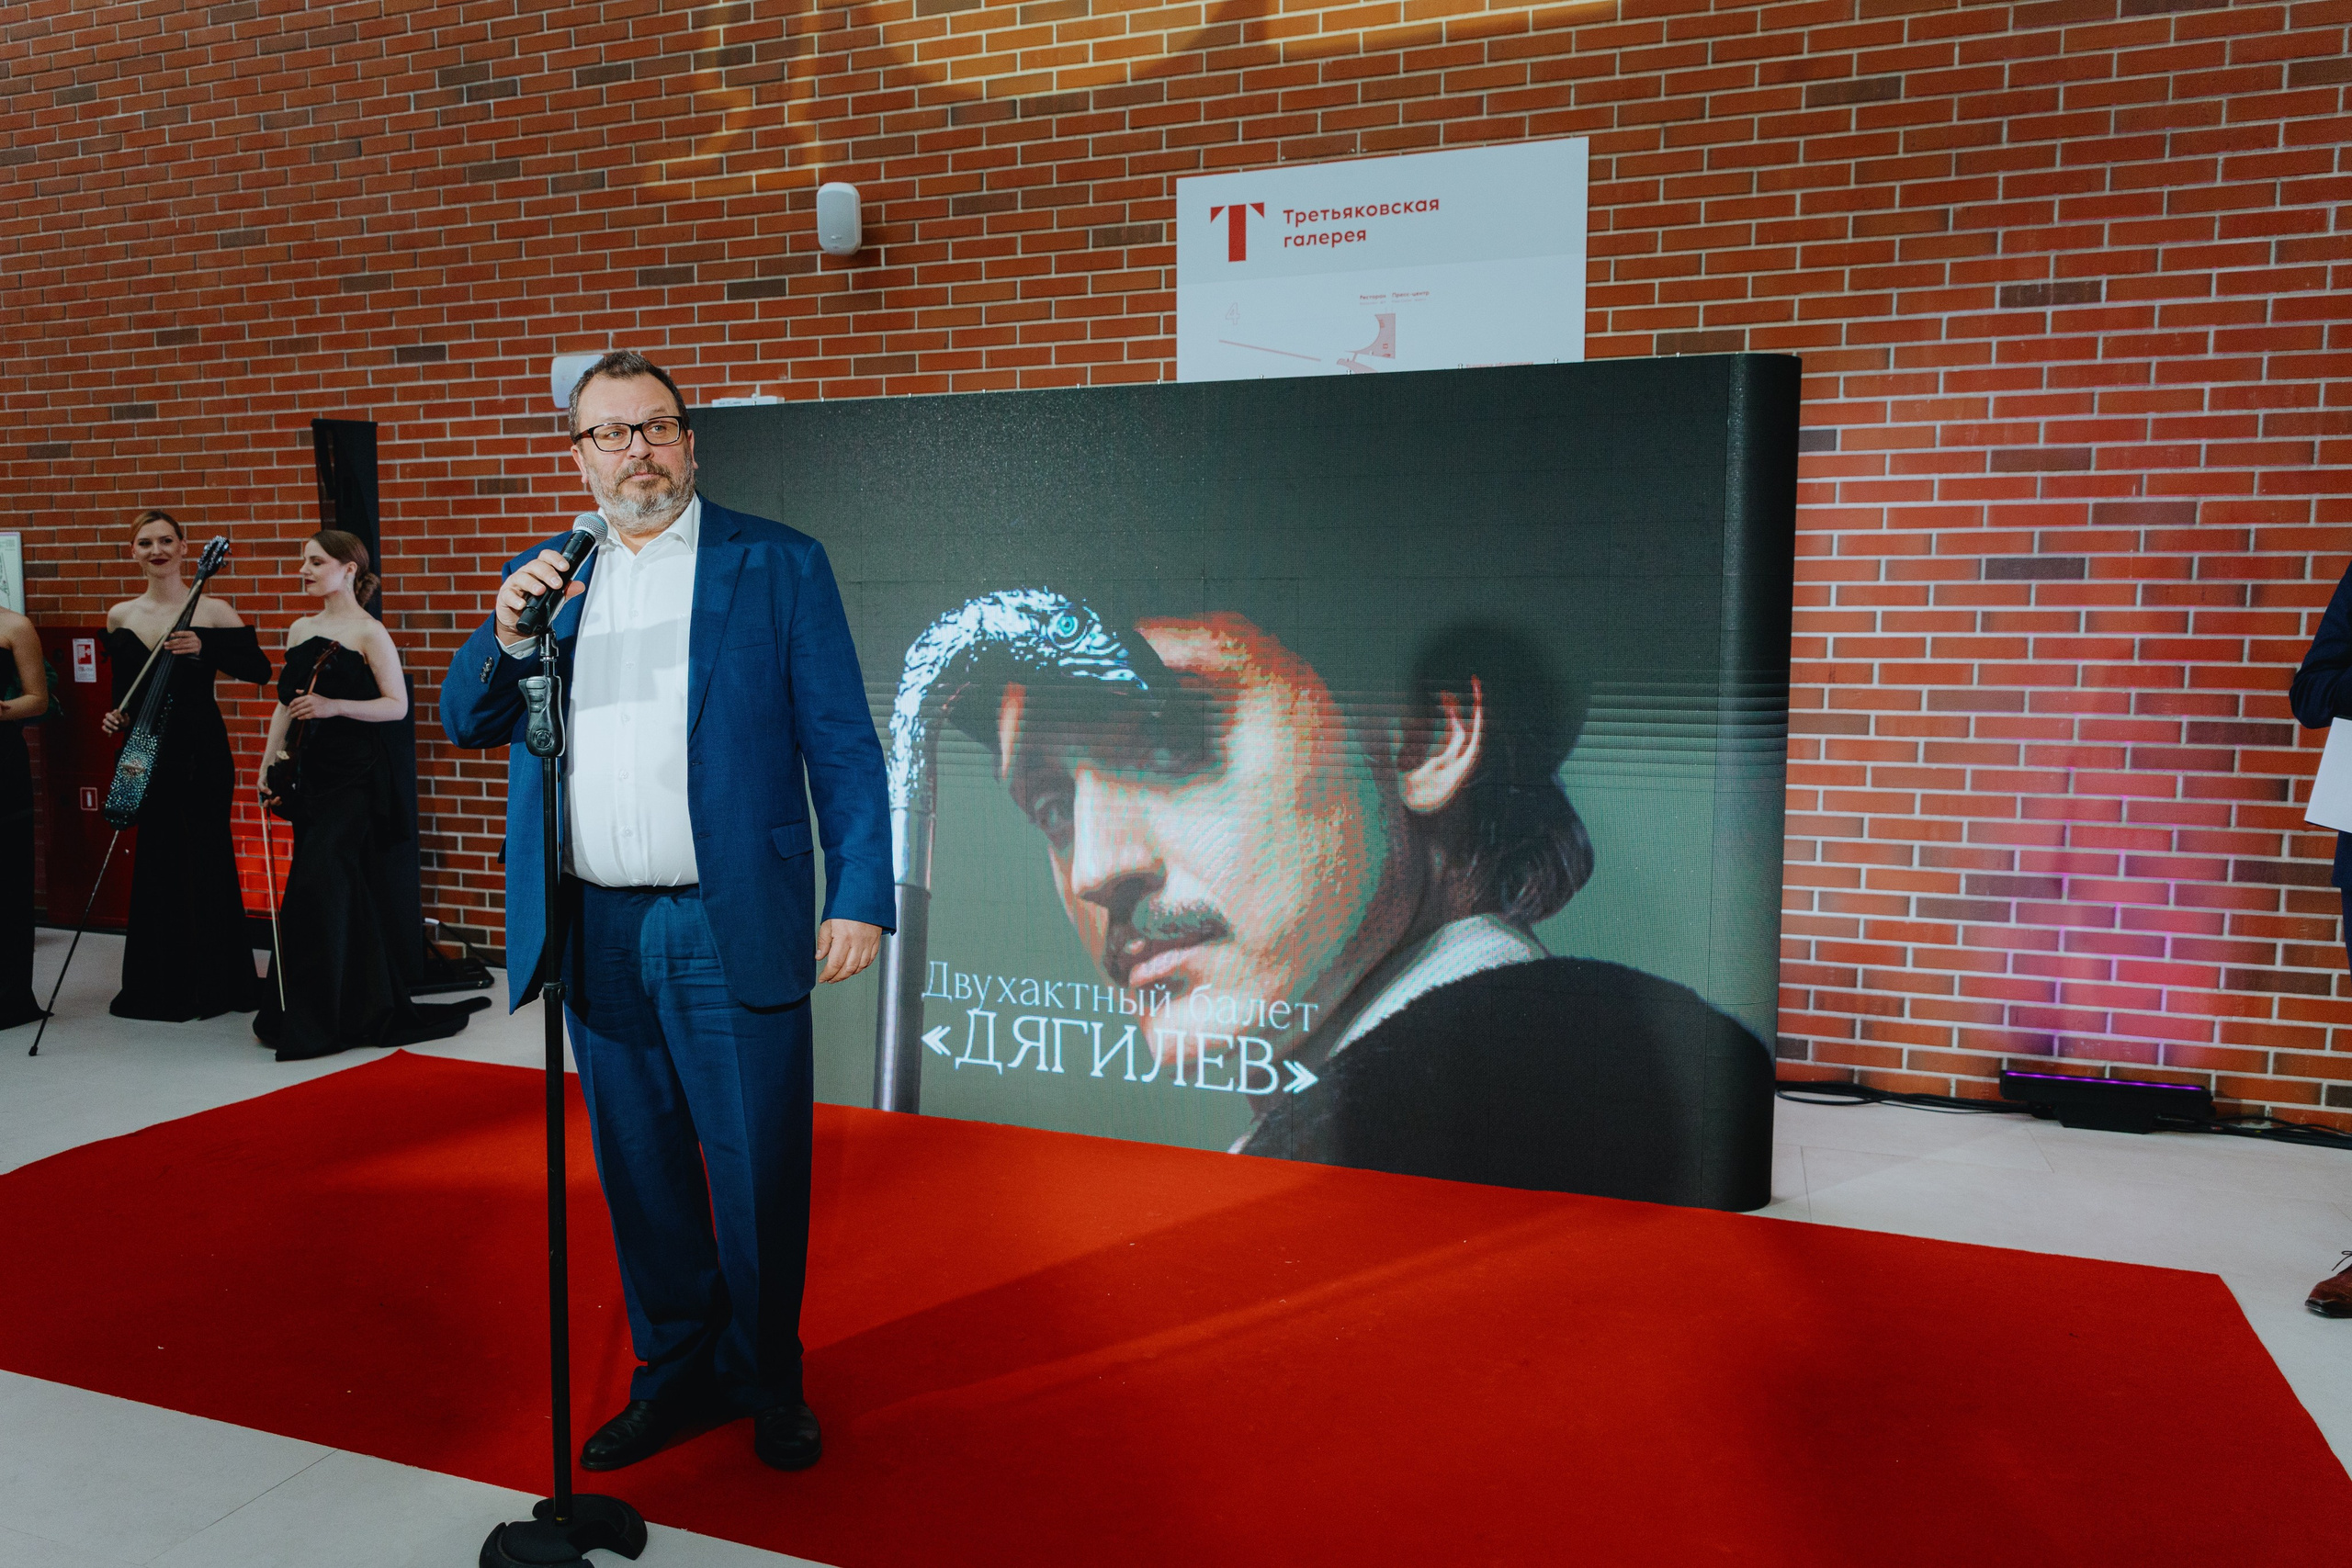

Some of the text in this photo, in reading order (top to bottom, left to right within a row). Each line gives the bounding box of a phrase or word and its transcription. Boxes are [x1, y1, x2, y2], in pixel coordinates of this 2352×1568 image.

[1283, 197, 1441, 228] Третьяковская
[1283, 229, 1367, 249] галерея
[921, 960, 1319, 1032] Двухактный балет
[920, 1009, 1319, 1096] «ДЯГИЛЕВ»
